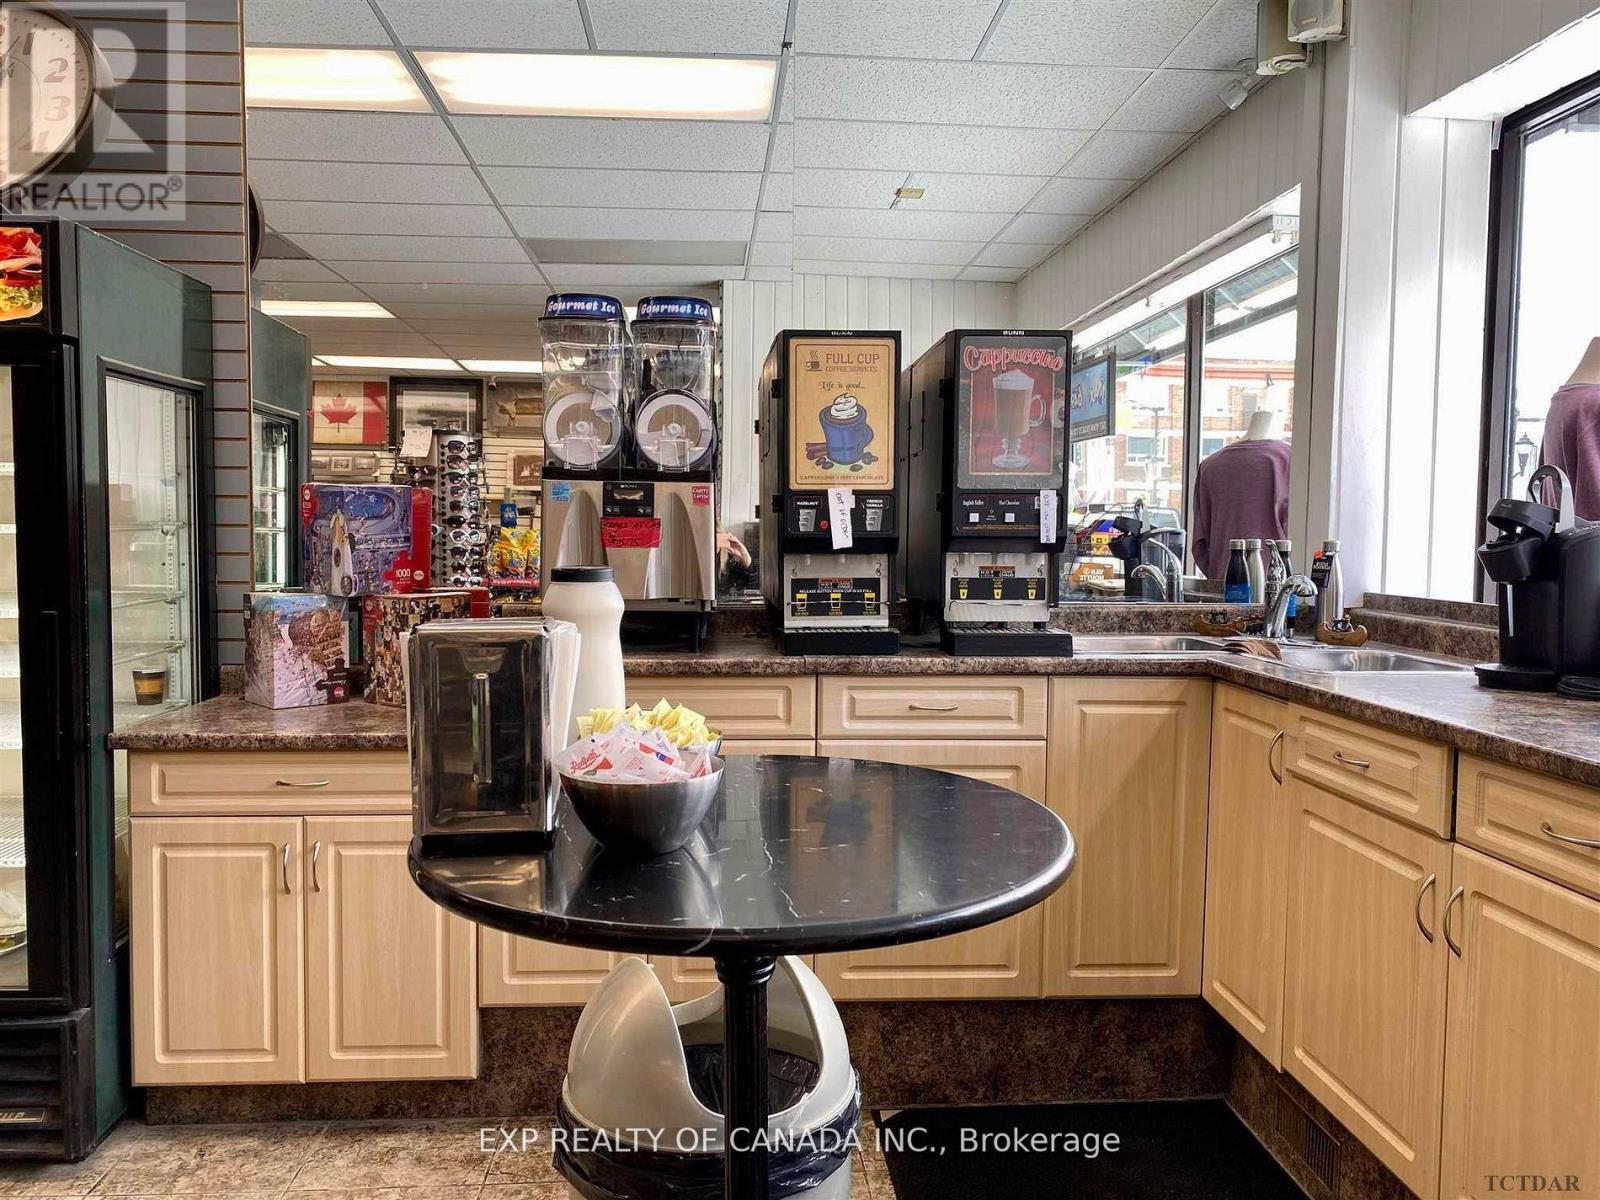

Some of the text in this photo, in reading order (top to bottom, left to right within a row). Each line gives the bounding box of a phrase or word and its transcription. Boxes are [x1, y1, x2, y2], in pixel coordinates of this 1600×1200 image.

[548, 299, 598, 312] Gourmet
[640, 301, 691, 314] Gourmet
[825, 353, 880, 364] FULL CUP
[963, 345, 1064, 372] Cappuccino
[825, 365, 847, 373] COFFEE
[819, 381, 835, 391] Life
[395, 568, 411, 578] 1000
